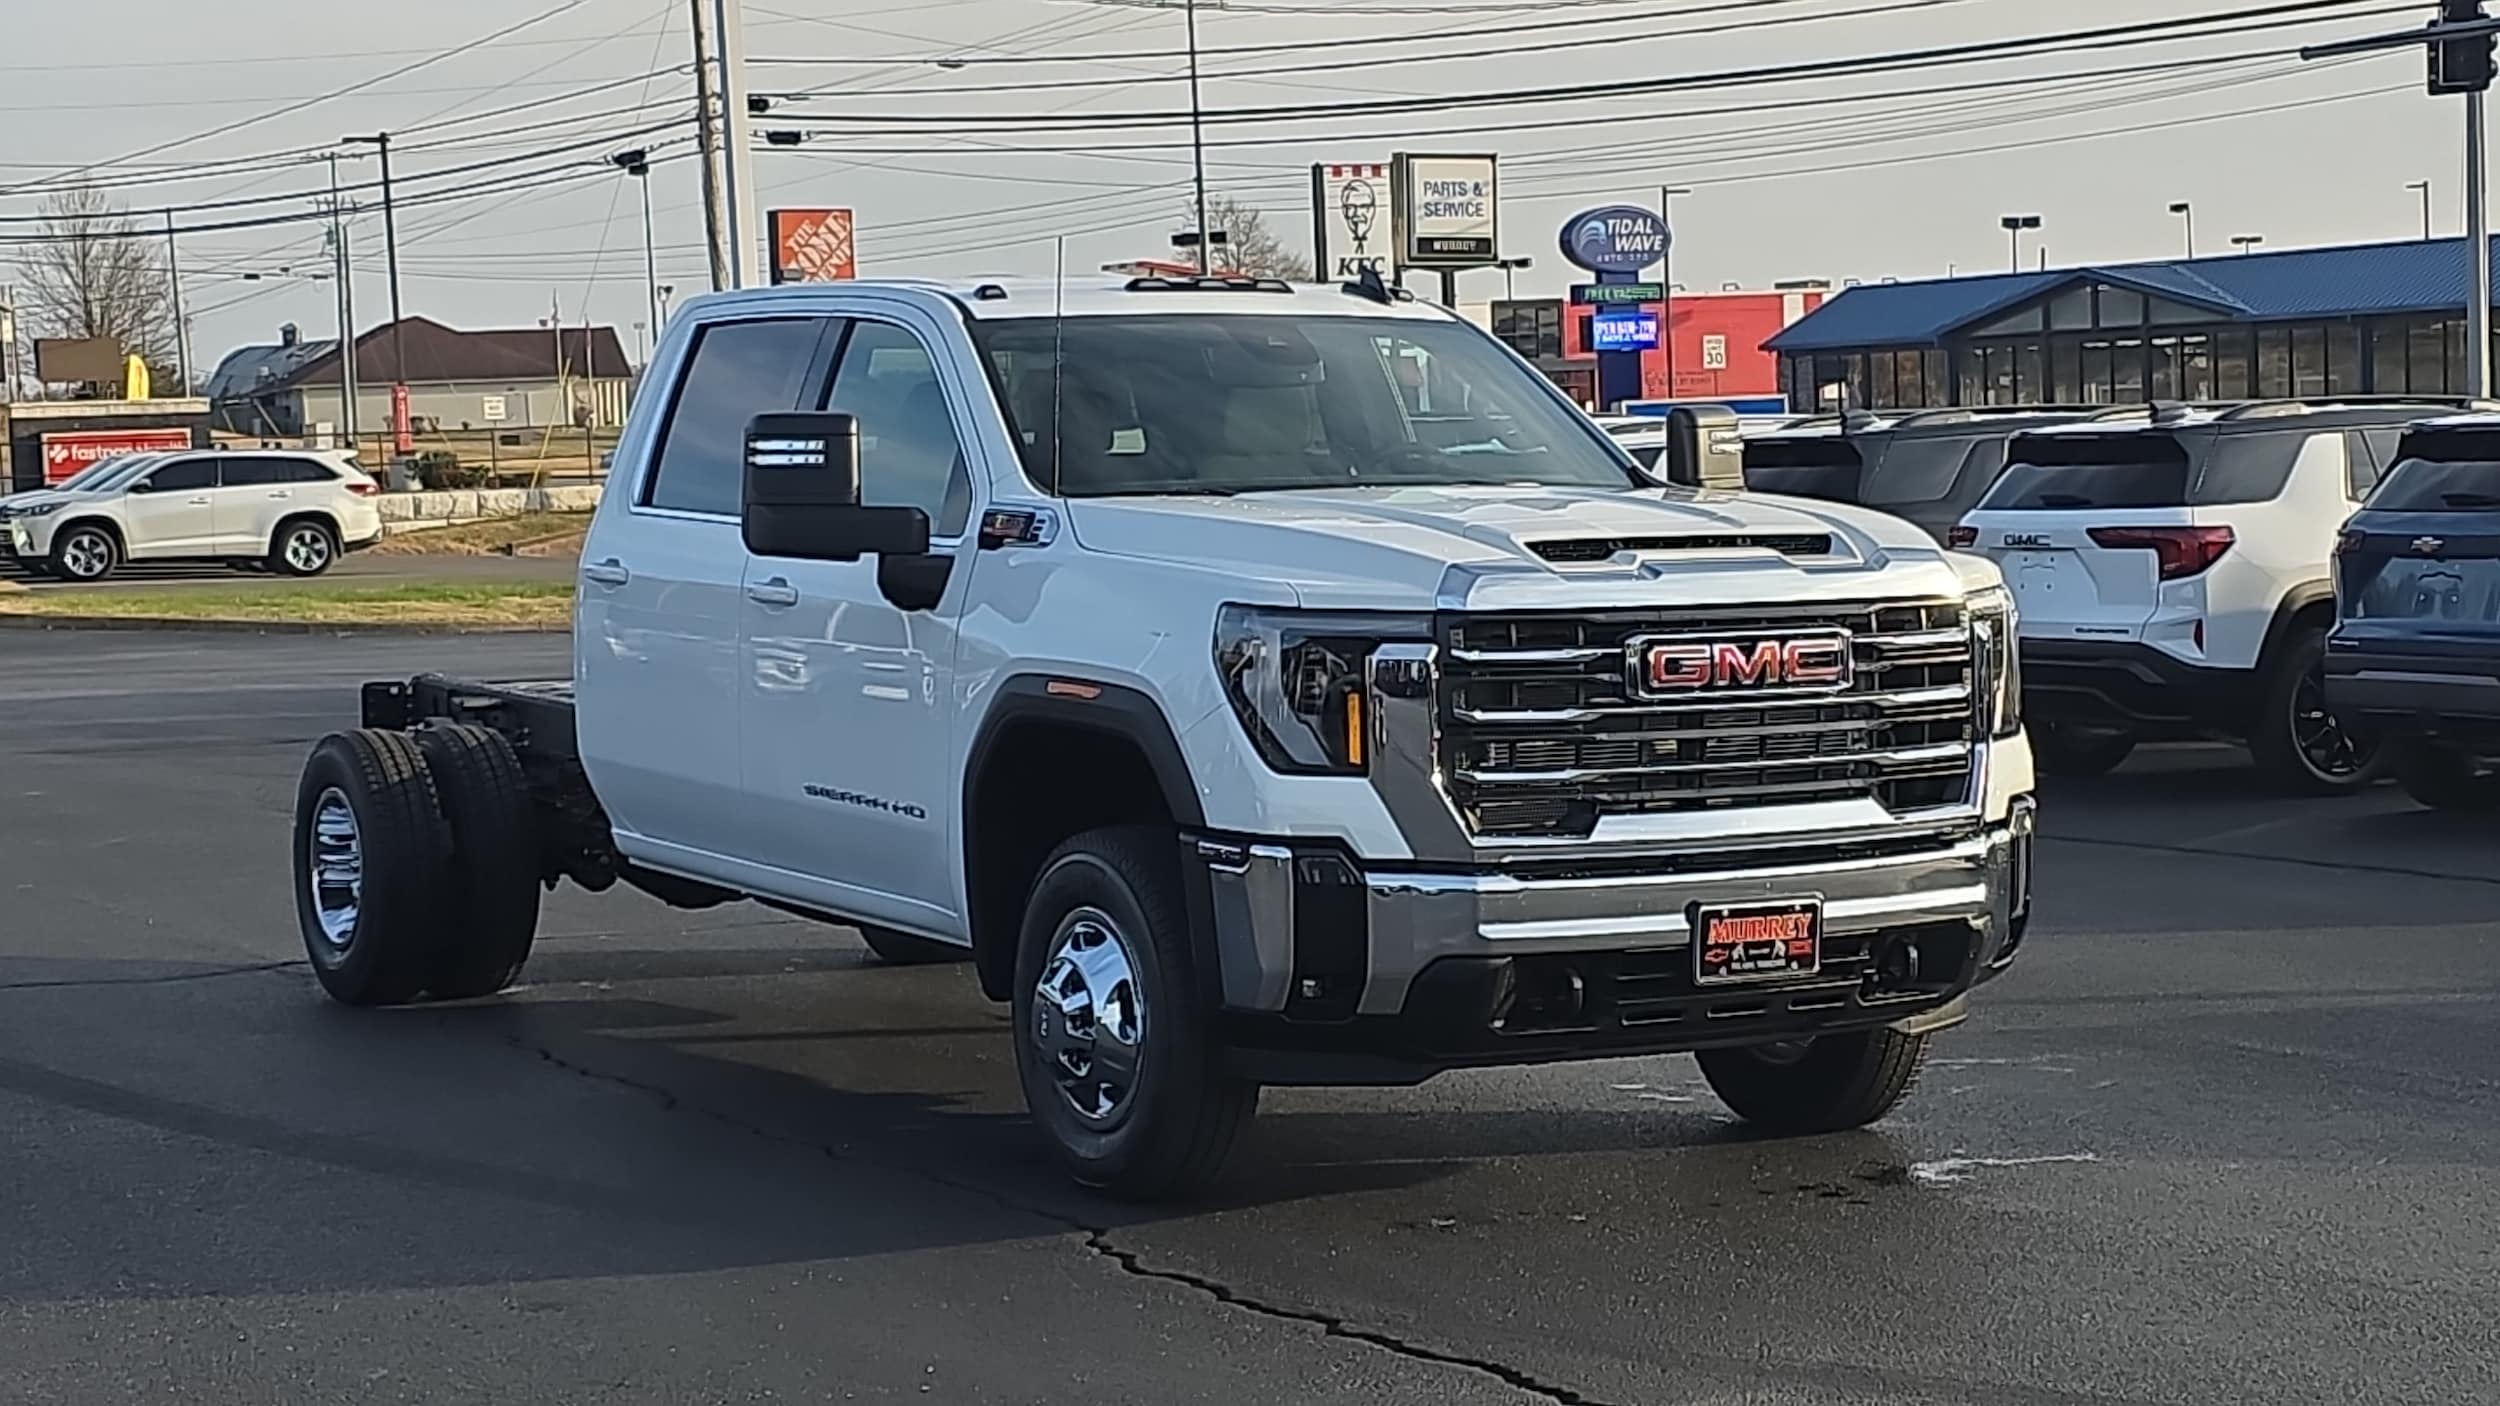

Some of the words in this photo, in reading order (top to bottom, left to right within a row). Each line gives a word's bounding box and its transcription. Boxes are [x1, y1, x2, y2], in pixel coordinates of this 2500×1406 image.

[1423, 181, 1468, 198] PARTS
[1472, 181, 1485, 197] &
[1423, 202, 1485, 218] SERVICE
[1606, 218, 1654, 235] TIDAL
[784, 219, 817, 253] THE
[788, 211, 851, 274] OME
[1614, 235, 1664, 252] WAVE
[1336, 257, 1387, 277] KFC
[1706, 351, 1724, 365] 30
[2003, 532, 2052, 547] GMC
[1648, 639, 1845, 688] GMC
[803, 784, 889, 811] SIERRA
[892, 803, 926, 819] HD
[1707, 913, 1813, 945] MURREY
